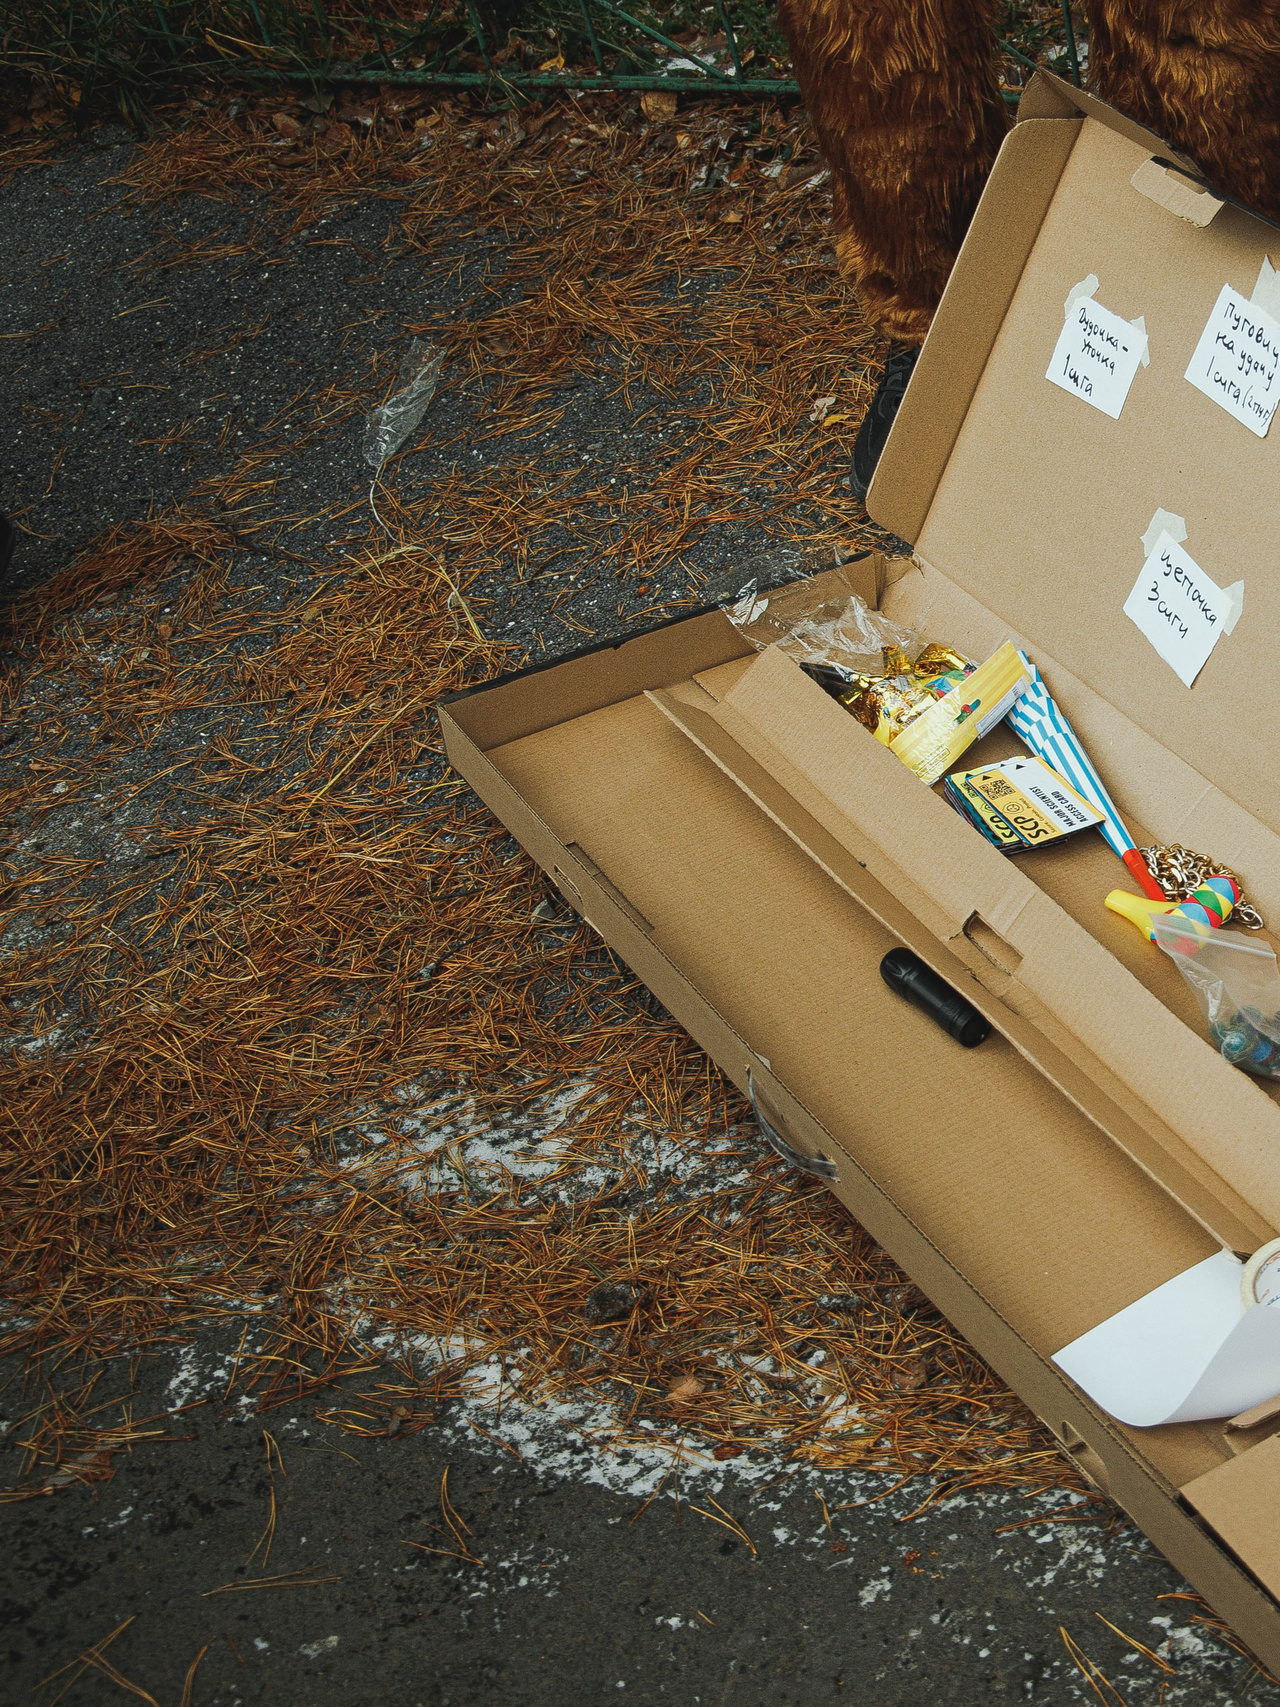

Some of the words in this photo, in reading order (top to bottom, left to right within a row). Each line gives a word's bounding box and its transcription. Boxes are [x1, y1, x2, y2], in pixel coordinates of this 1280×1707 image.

[1215, 331, 1235, 355] на
[1237, 352, 1275, 392] удачу
[1029, 786, 1059, 810] SCIENTIST
[1051, 790, 1069, 807] CARD
[1054, 808, 1076, 828] MAJOR
[1065, 804, 1089, 822] ACCESS
[1013, 816, 1049, 839] SCP
